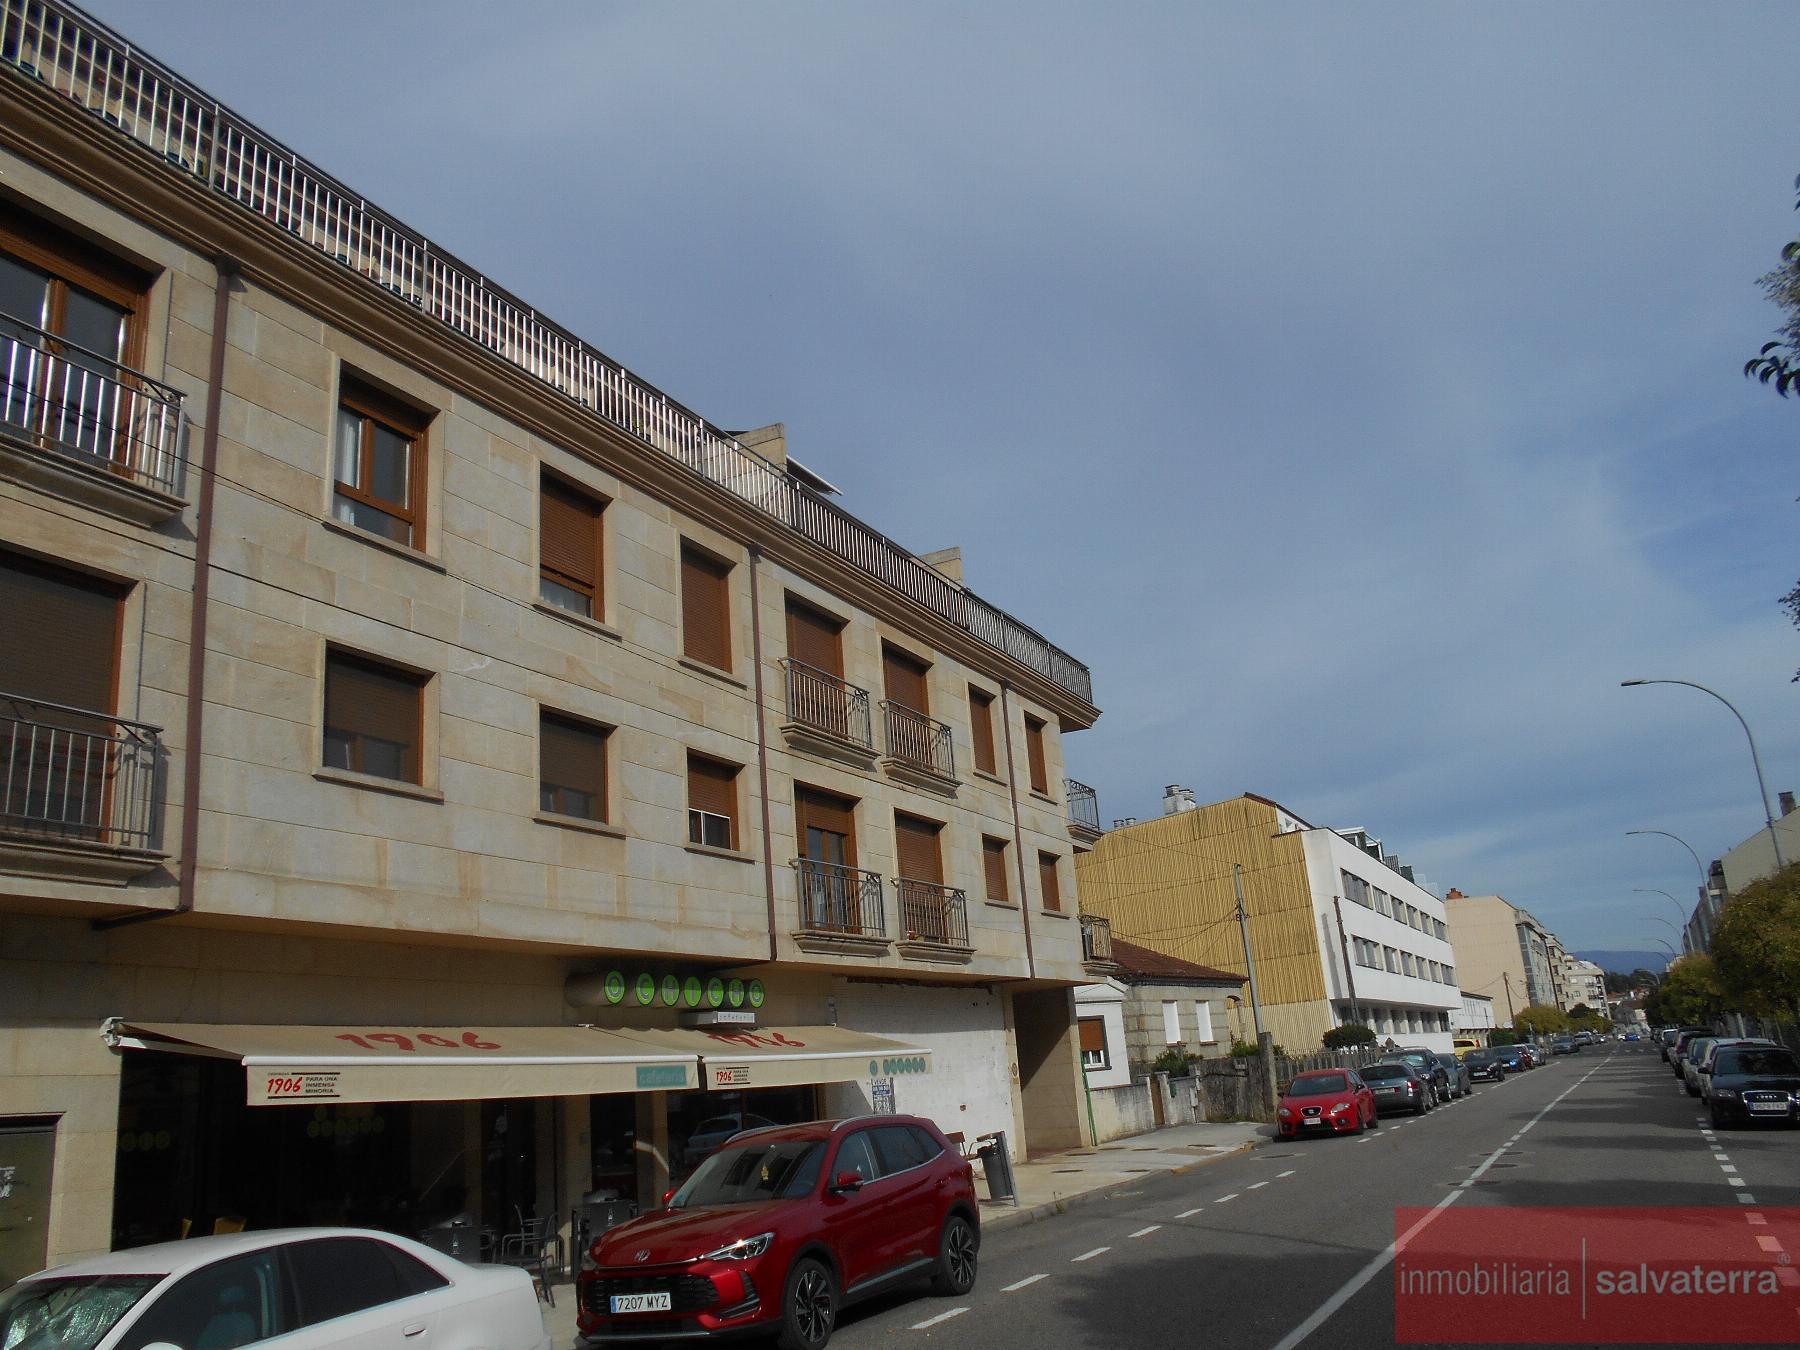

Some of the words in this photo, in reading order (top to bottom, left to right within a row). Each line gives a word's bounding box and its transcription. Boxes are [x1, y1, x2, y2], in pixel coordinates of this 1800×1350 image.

[335, 1031, 501, 1051] 1906
[707, 1032, 805, 1048] 1906
[716, 1071, 732, 1082] 1906
[267, 1077, 303, 1094] 1906
[618, 1297, 643, 1310] 7207
[647, 1296, 667, 1308] MYZ
